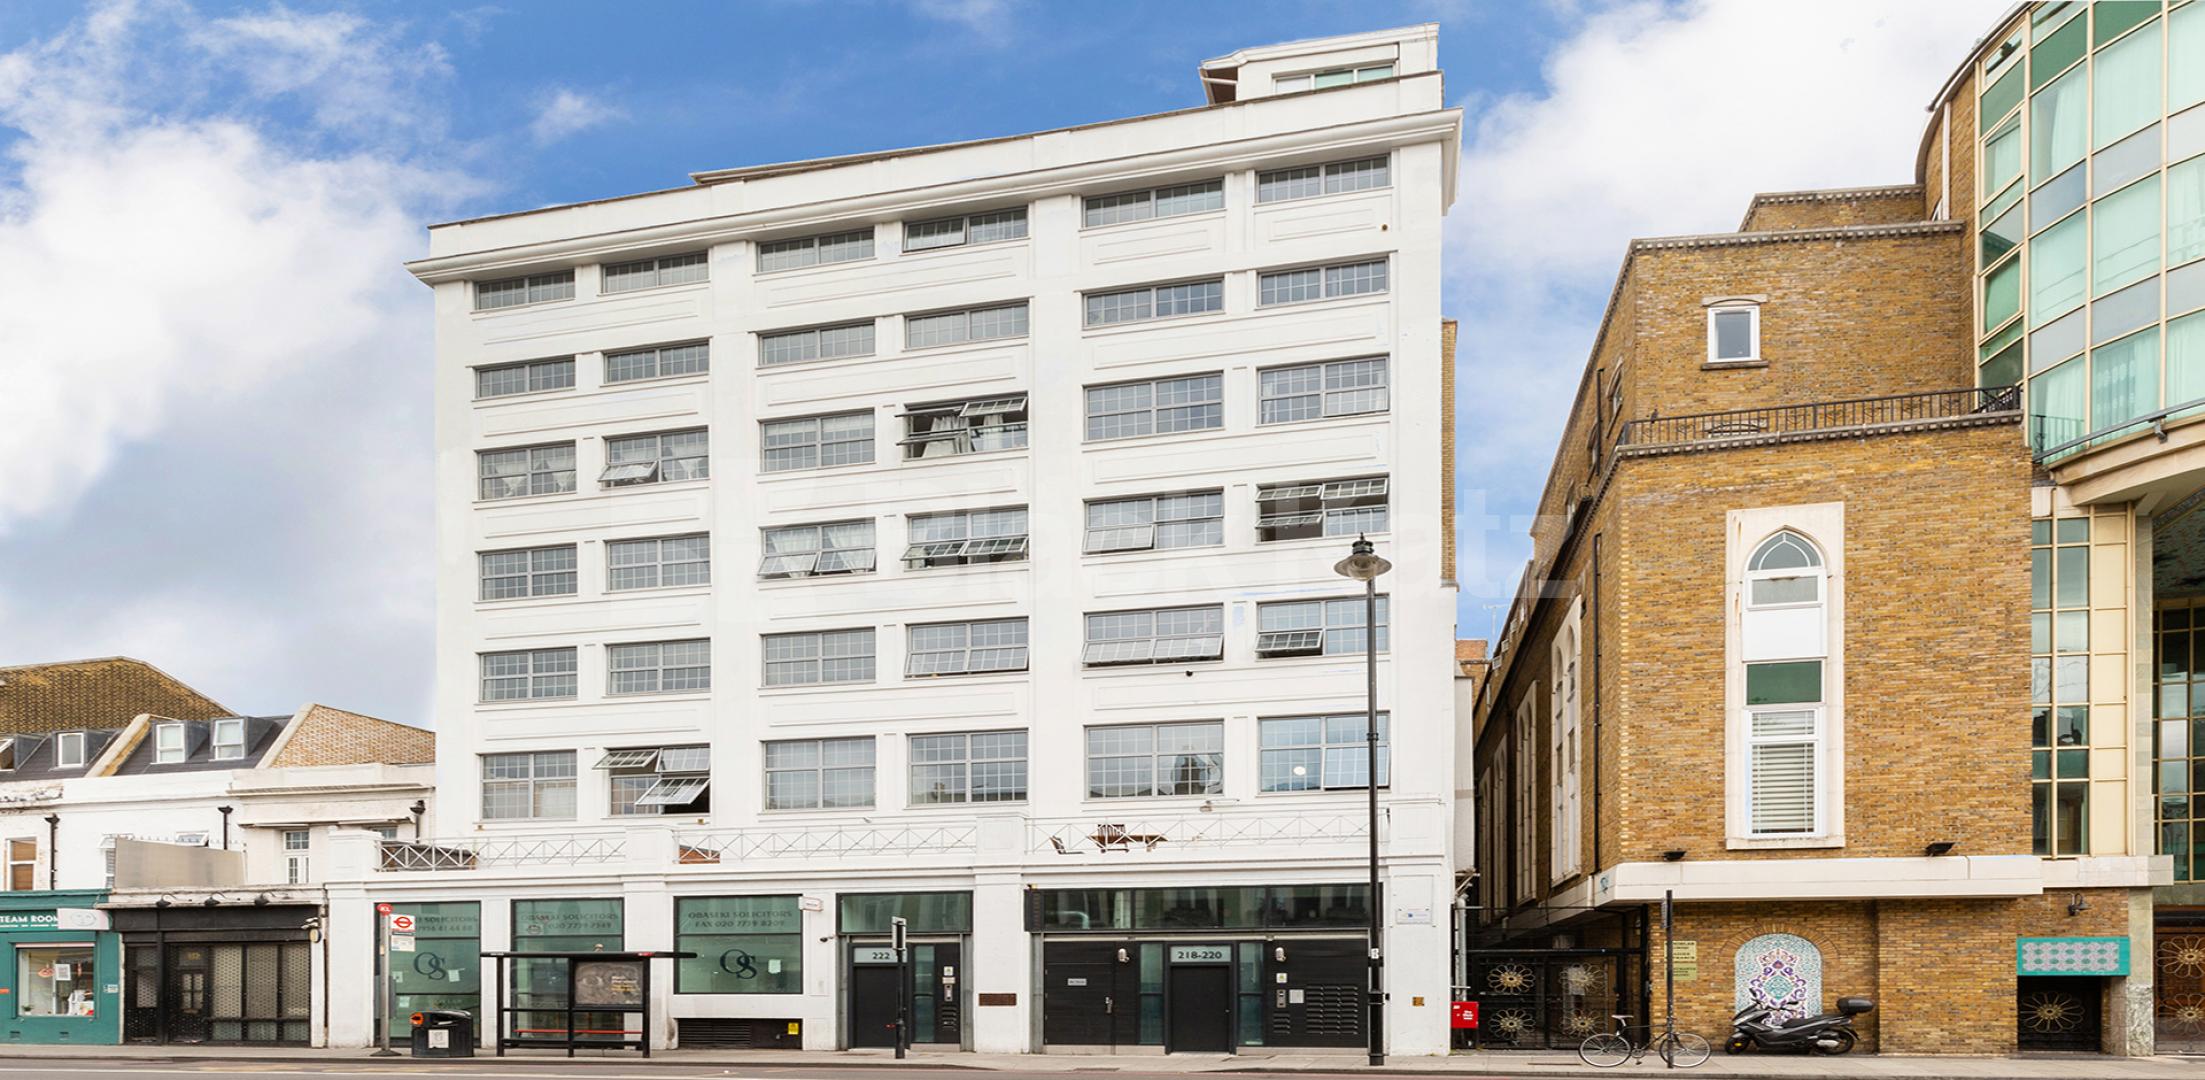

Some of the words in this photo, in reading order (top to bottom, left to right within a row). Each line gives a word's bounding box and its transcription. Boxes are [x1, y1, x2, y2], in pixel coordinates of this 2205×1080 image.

[733, 910, 793, 919] SOLICITORS
[872, 952, 891, 960] 222
[1178, 951, 1223, 960] 218-220
